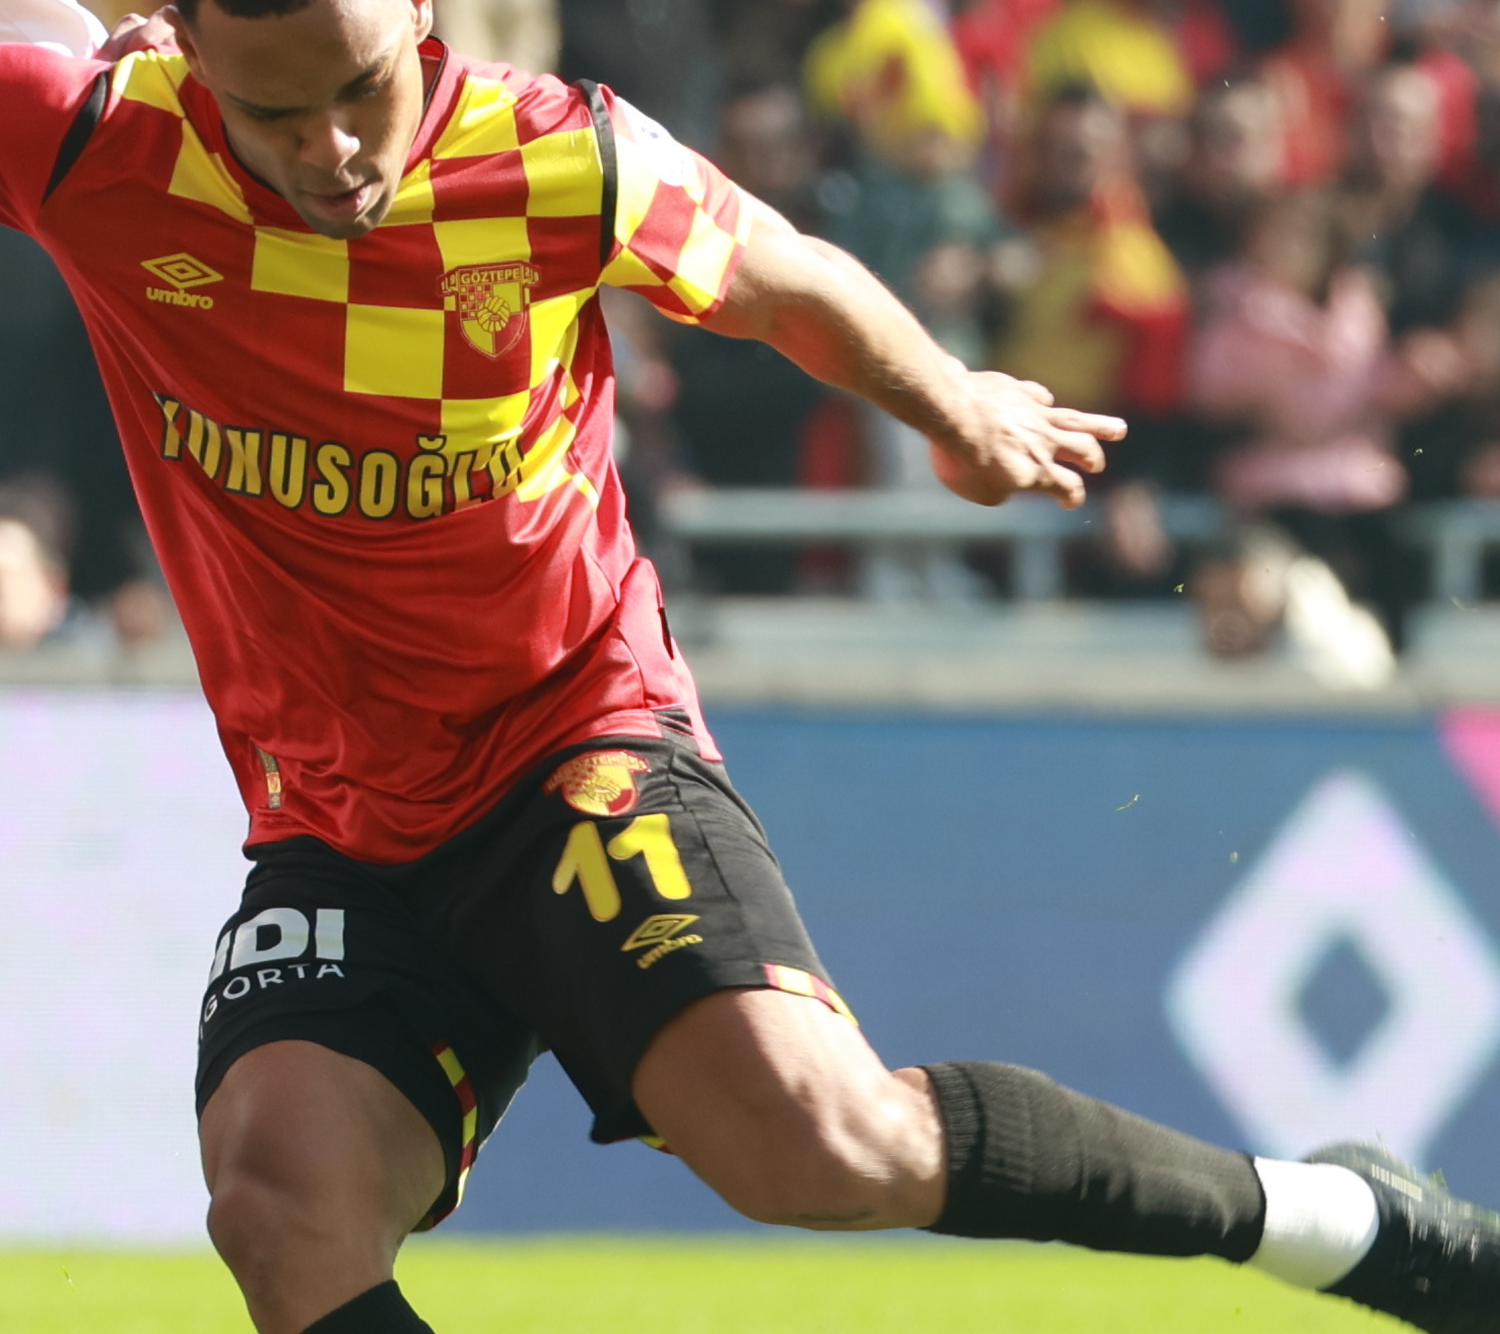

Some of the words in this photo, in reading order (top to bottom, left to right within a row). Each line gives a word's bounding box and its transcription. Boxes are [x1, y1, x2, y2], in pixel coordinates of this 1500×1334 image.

[460, 268, 520, 285] GÖZTEPE
[145, 287, 214, 310] umbro
[552, 813, 692, 922] 11
[202, 963, 345, 1025] GORTA
